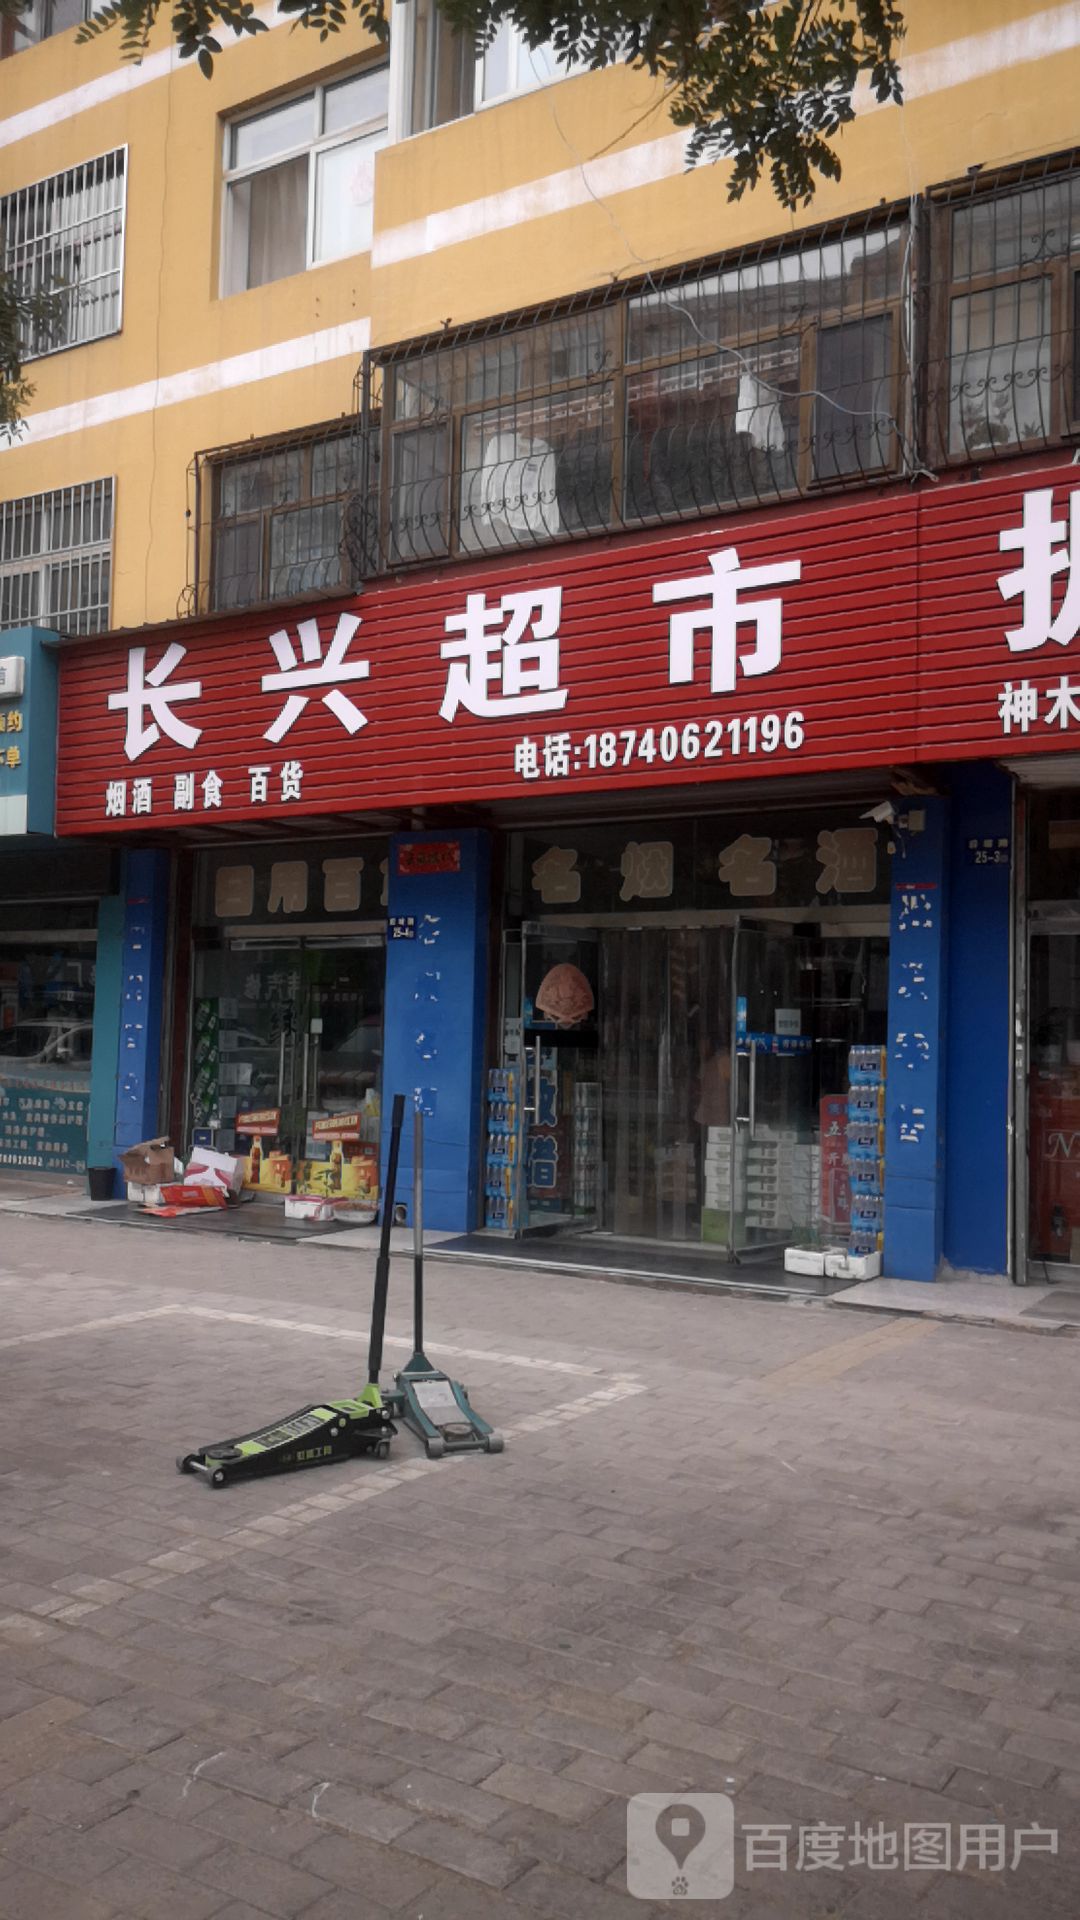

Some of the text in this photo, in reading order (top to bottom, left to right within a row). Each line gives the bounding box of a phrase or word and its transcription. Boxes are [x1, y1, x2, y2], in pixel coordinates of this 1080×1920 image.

[107, 545, 803, 763] 长兴超市
[998, 675, 1080, 735] 神木
[513, 709, 806, 781] 电话:18740621196
[104, 760, 305, 818] 烟酒 副食 百货
[214, 856, 389, 918] 日用百
[531, 827, 879, 905] 名烟名酒
